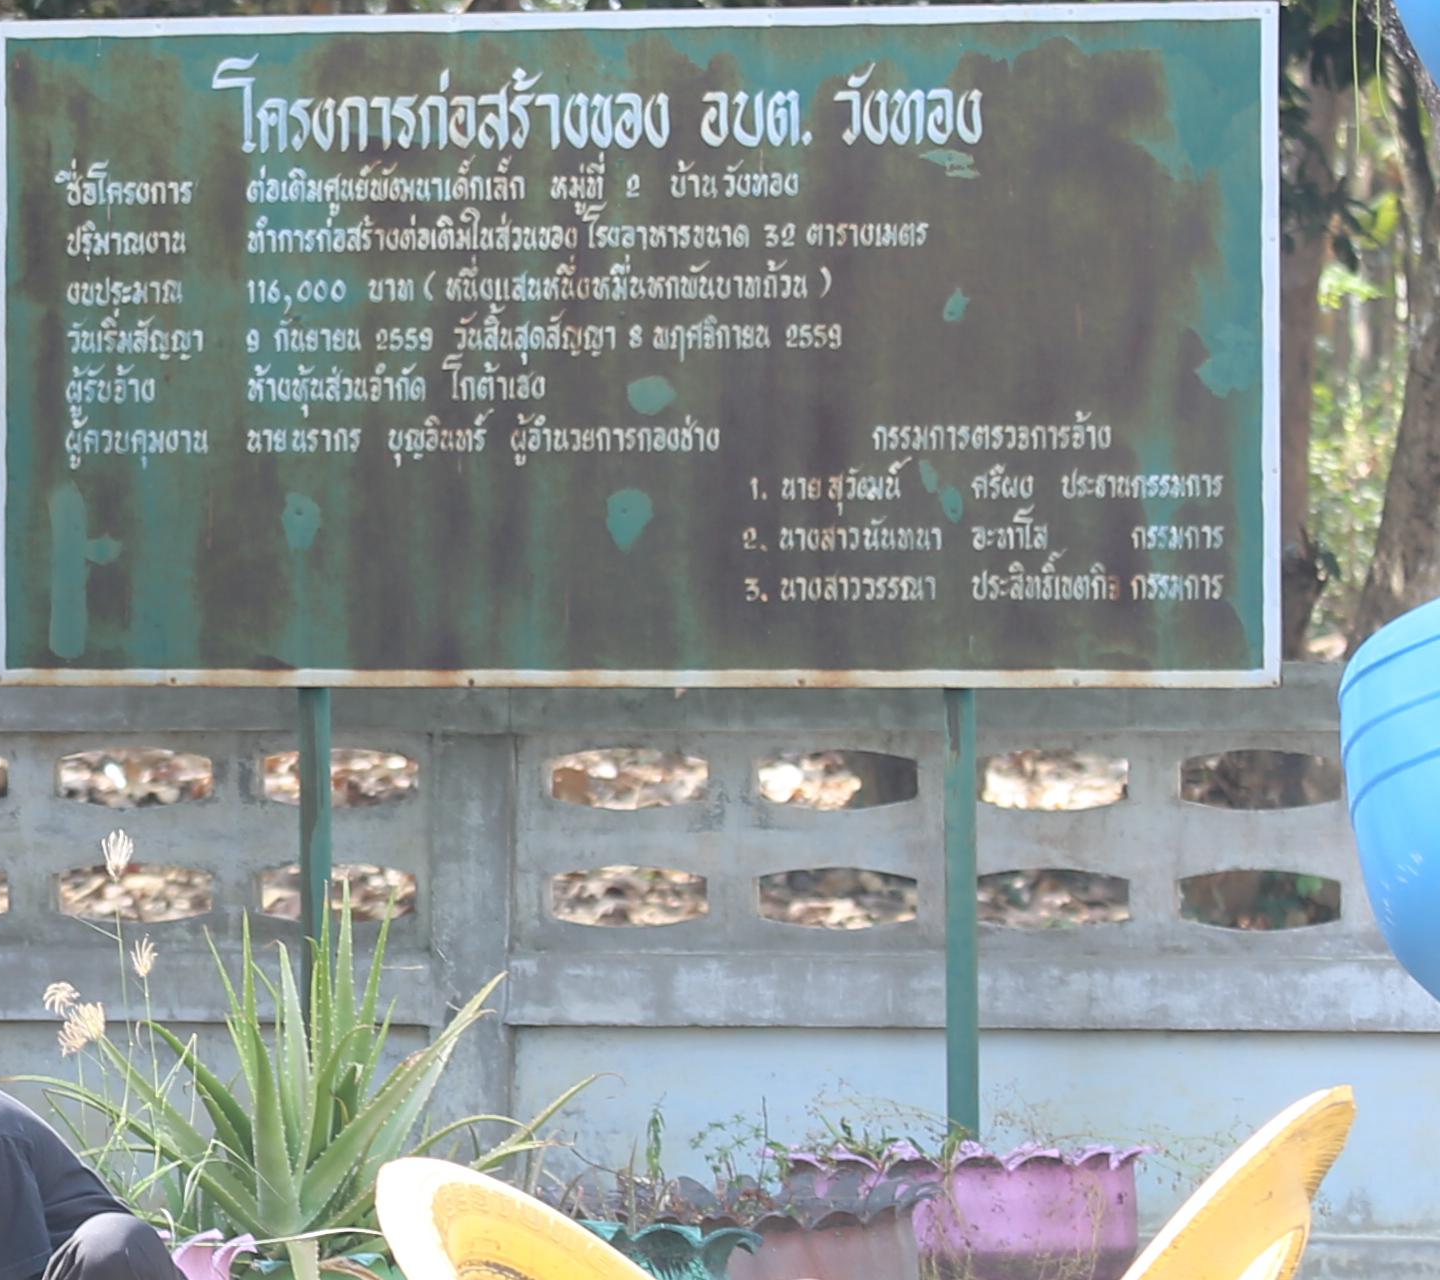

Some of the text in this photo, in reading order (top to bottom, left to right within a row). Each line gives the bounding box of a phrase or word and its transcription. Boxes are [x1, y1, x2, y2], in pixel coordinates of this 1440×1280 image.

[212, 53, 984, 153] โครงการก่อสร้างของ อบต. วังทอง
[54, 157, 193, 206] ชื่อโครงการ
[246, 154, 526, 217] ต่อเติมศูนย์พัฒนาเด็กเล็ก
[550, 151, 606, 215] หมู่ที่
[626, 174, 641, 198] 2
[66, 220, 187, 261] ปริมาณงาน
[763, 223, 795, 248] 32
[805, 221, 930, 248] ตารางเมตร
[66, 276, 183, 306] งบประมาณ
[247, 277, 347, 314] 116,000
[368, 277, 415, 303] บาท
[66, 305, 204, 361] วันเริ่มสัญญา
[246, 327, 261, 354] 9
[274, 316, 362, 351] กันยายน
[376, 326, 433, 353] 2559
[453, 303, 616, 366] วันสิ้นสุดสัญญา
[652, 314, 771, 363] พฤศจิกายน
[785, 323, 843, 349] 2559
[65, 363, 156, 419] ผู้รับจ้าง
[247, 362, 427, 418] ห้างหุ้นส่วนจำกัด
[65, 414, 209, 470] ผู้ควบคุมงาน
[510, 413, 720, 467] ผู้อำนวยการกองช่าง
[871, 409, 1113, 452] กรรมการตรวจการจ้าง
[1061, 468, 1225, 499] ประธานกรรมการ
[1131, 523, 1225, 552] กรรมการ
[1131, 574, 1225, 601] กรรมการ
